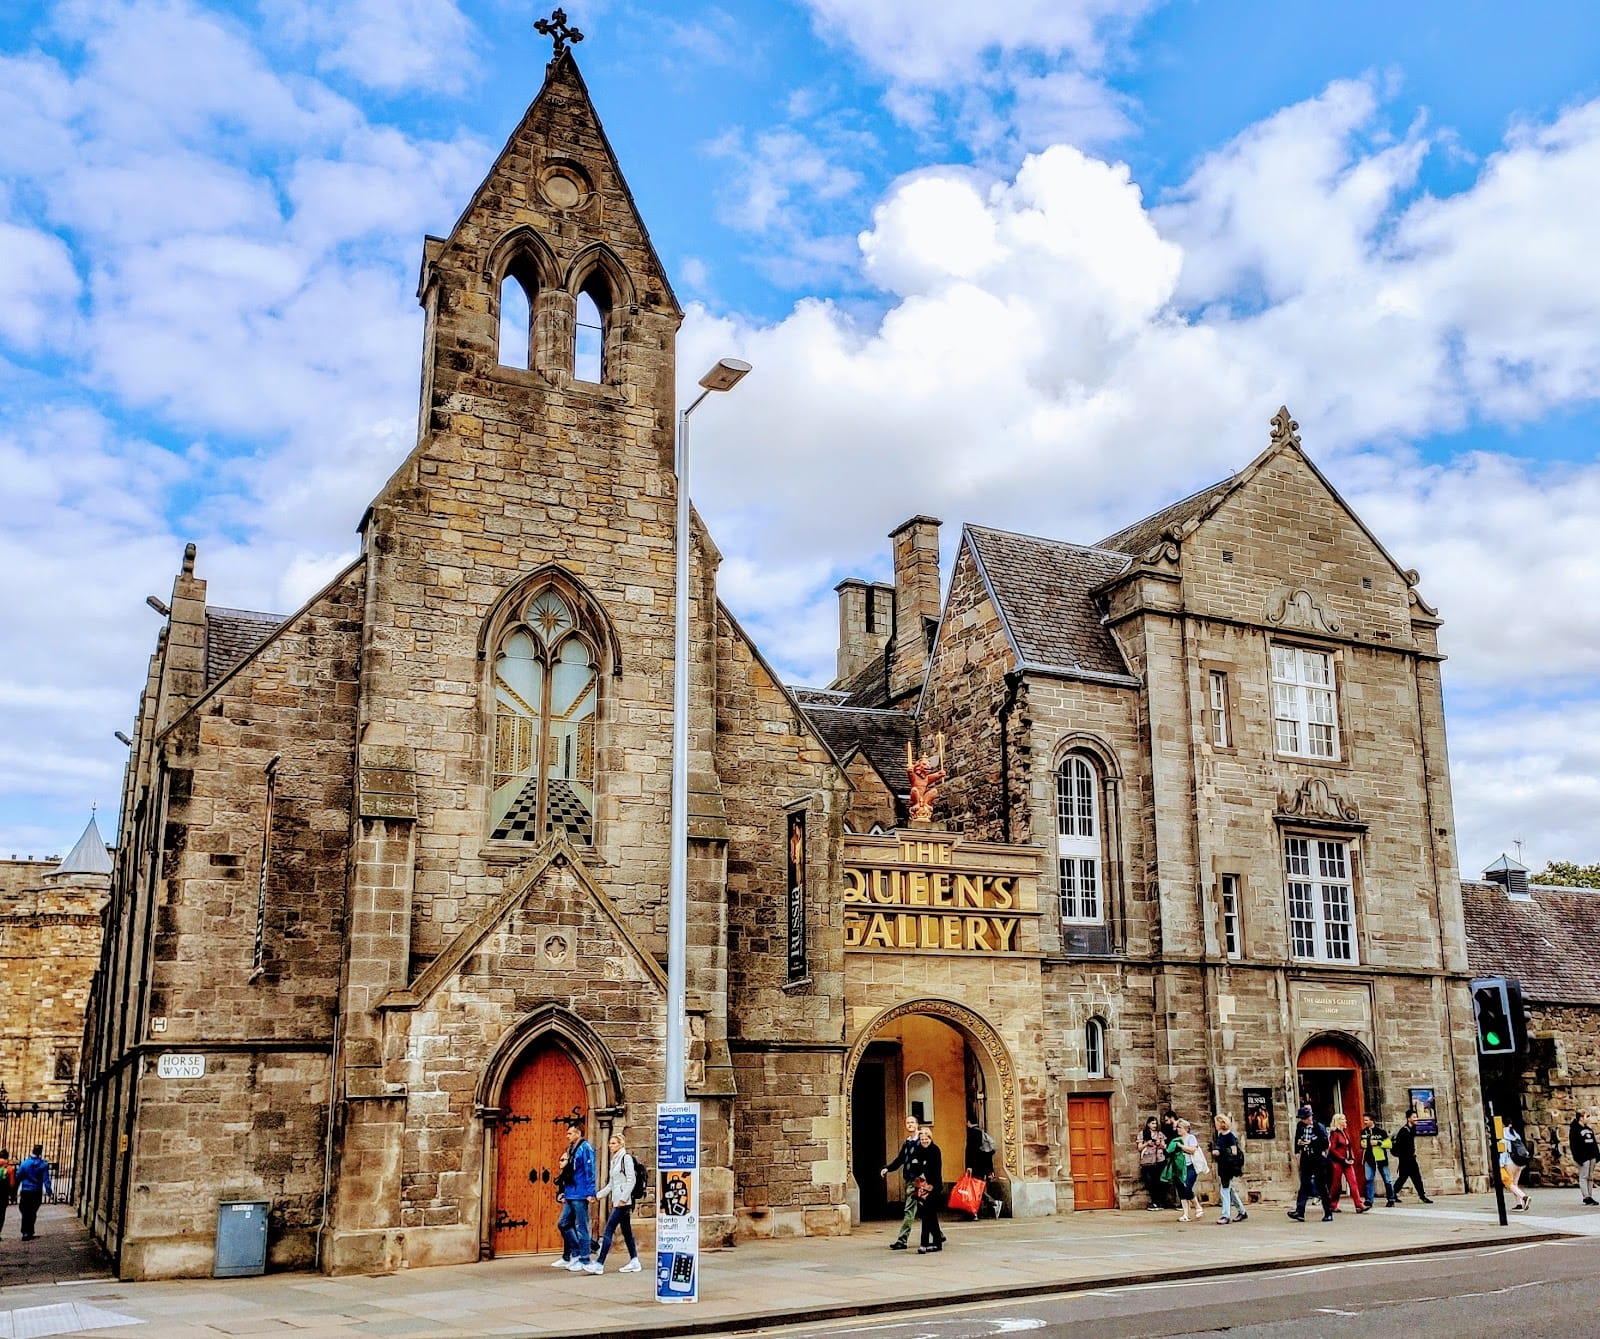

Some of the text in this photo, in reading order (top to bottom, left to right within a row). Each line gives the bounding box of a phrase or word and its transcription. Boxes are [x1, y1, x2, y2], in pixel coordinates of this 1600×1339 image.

[904, 841, 950, 864] THE
[844, 868, 1013, 909] QUEEN'S
[844, 912, 1017, 951] GALLERY
[163, 1056, 200, 1066] HORSE
[163, 1067, 200, 1076] WYND
